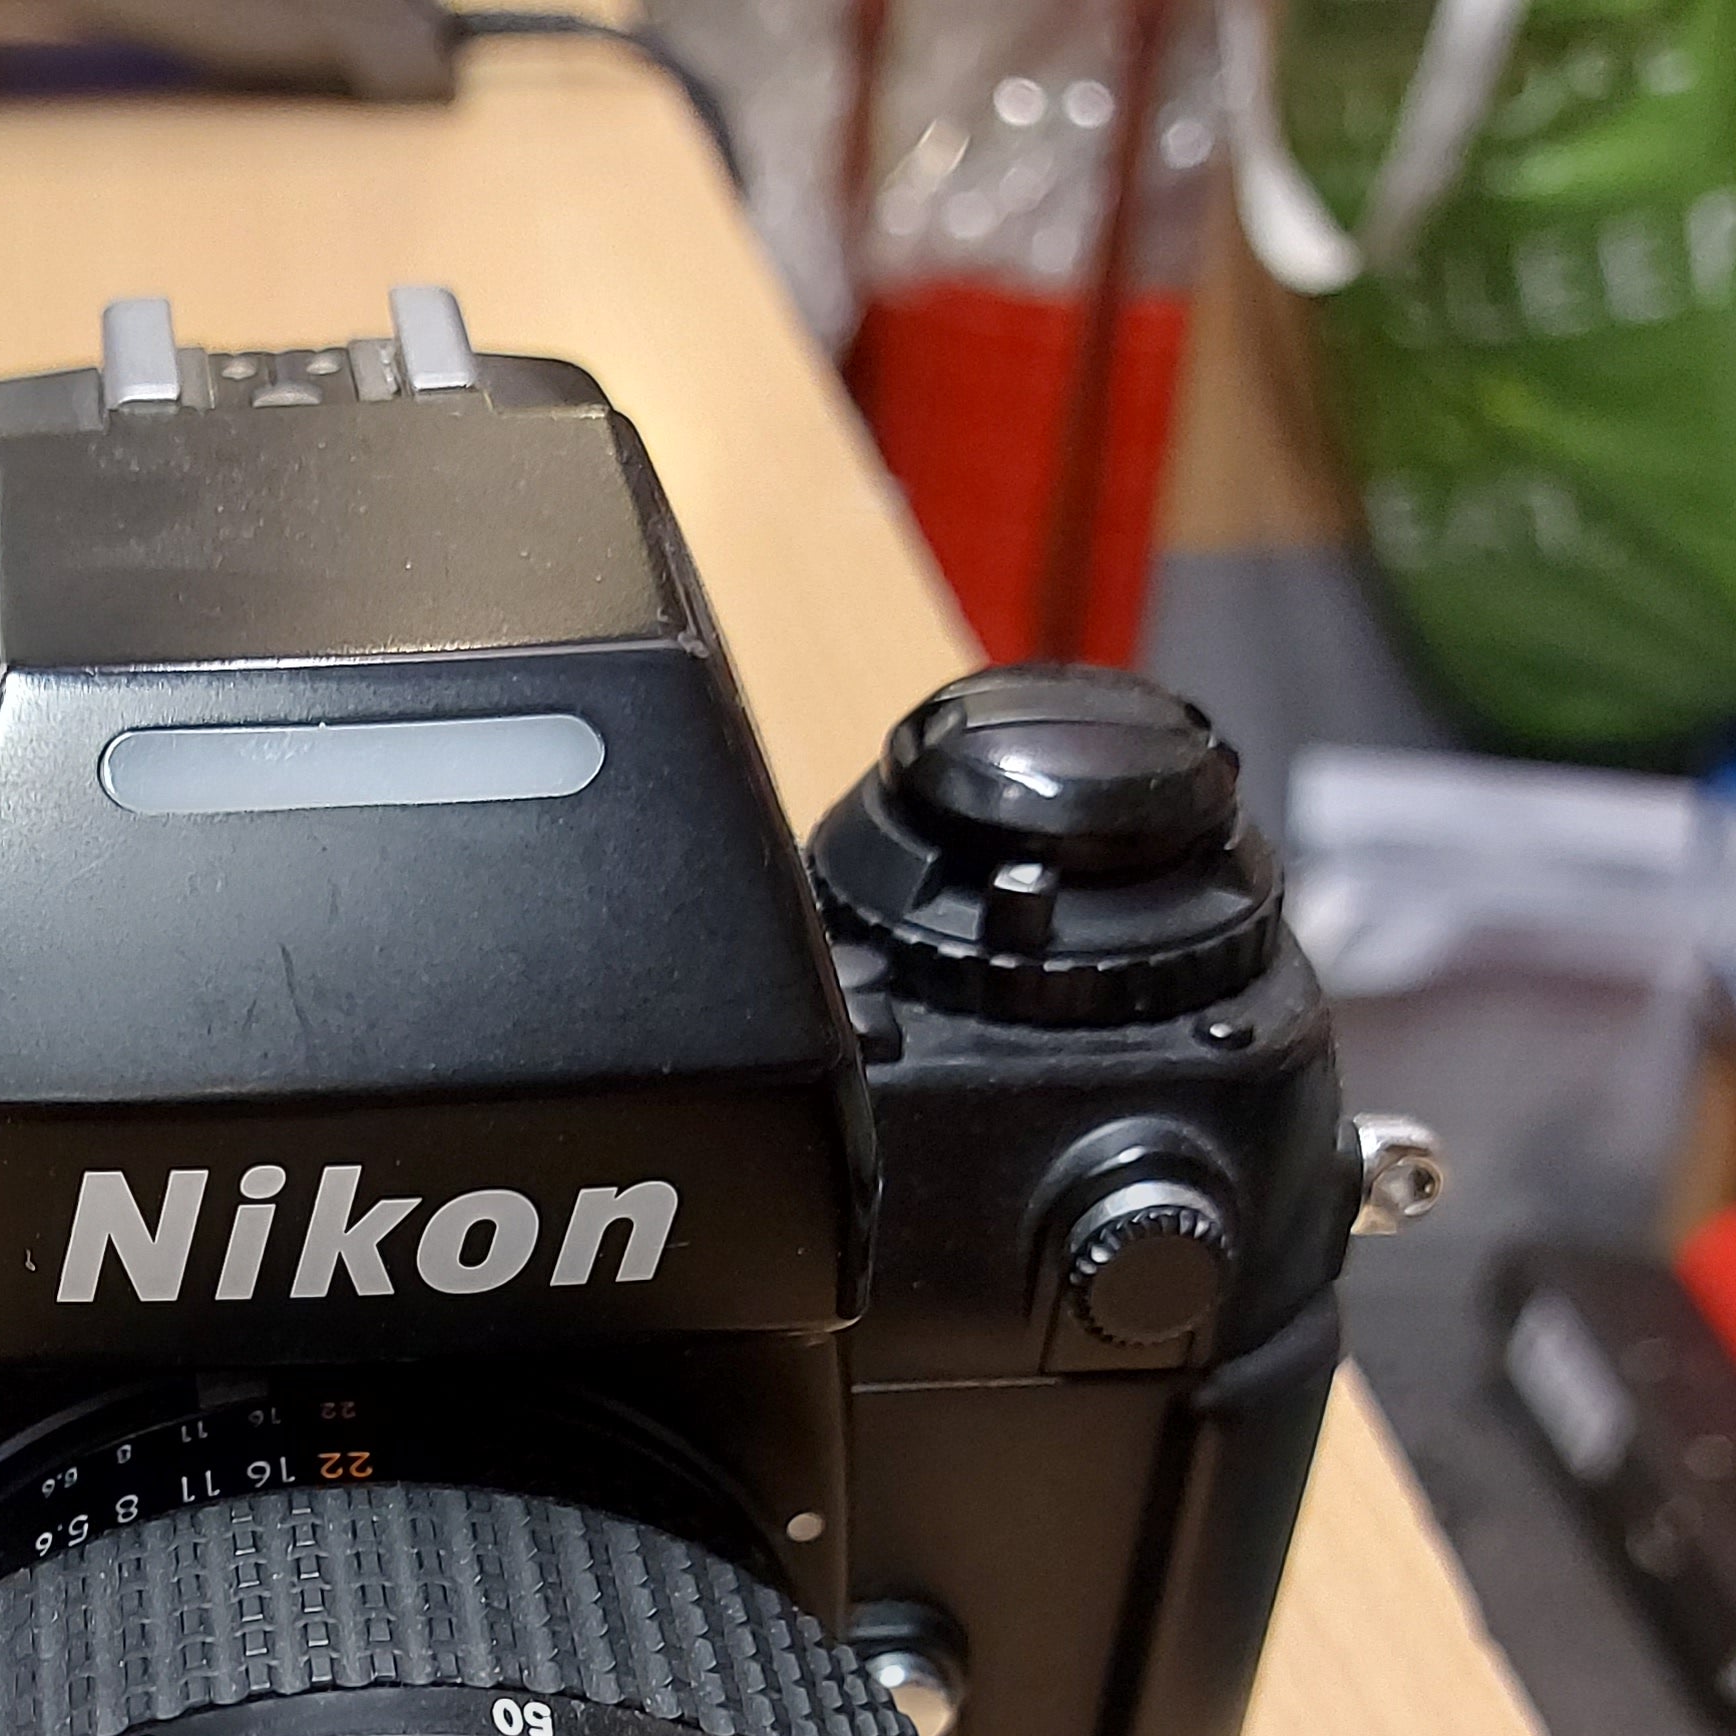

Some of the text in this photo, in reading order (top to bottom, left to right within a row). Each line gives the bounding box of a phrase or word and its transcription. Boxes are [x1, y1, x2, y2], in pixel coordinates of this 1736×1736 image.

[56, 1164, 679, 1303] Nikon
[35, 1514, 89, 1557] 5.6
[115, 1494, 139, 1524] 8
[181, 1469, 221, 1503] 11
[246, 1456, 296, 1488] 16
[317, 1451, 374, 1479] 22
